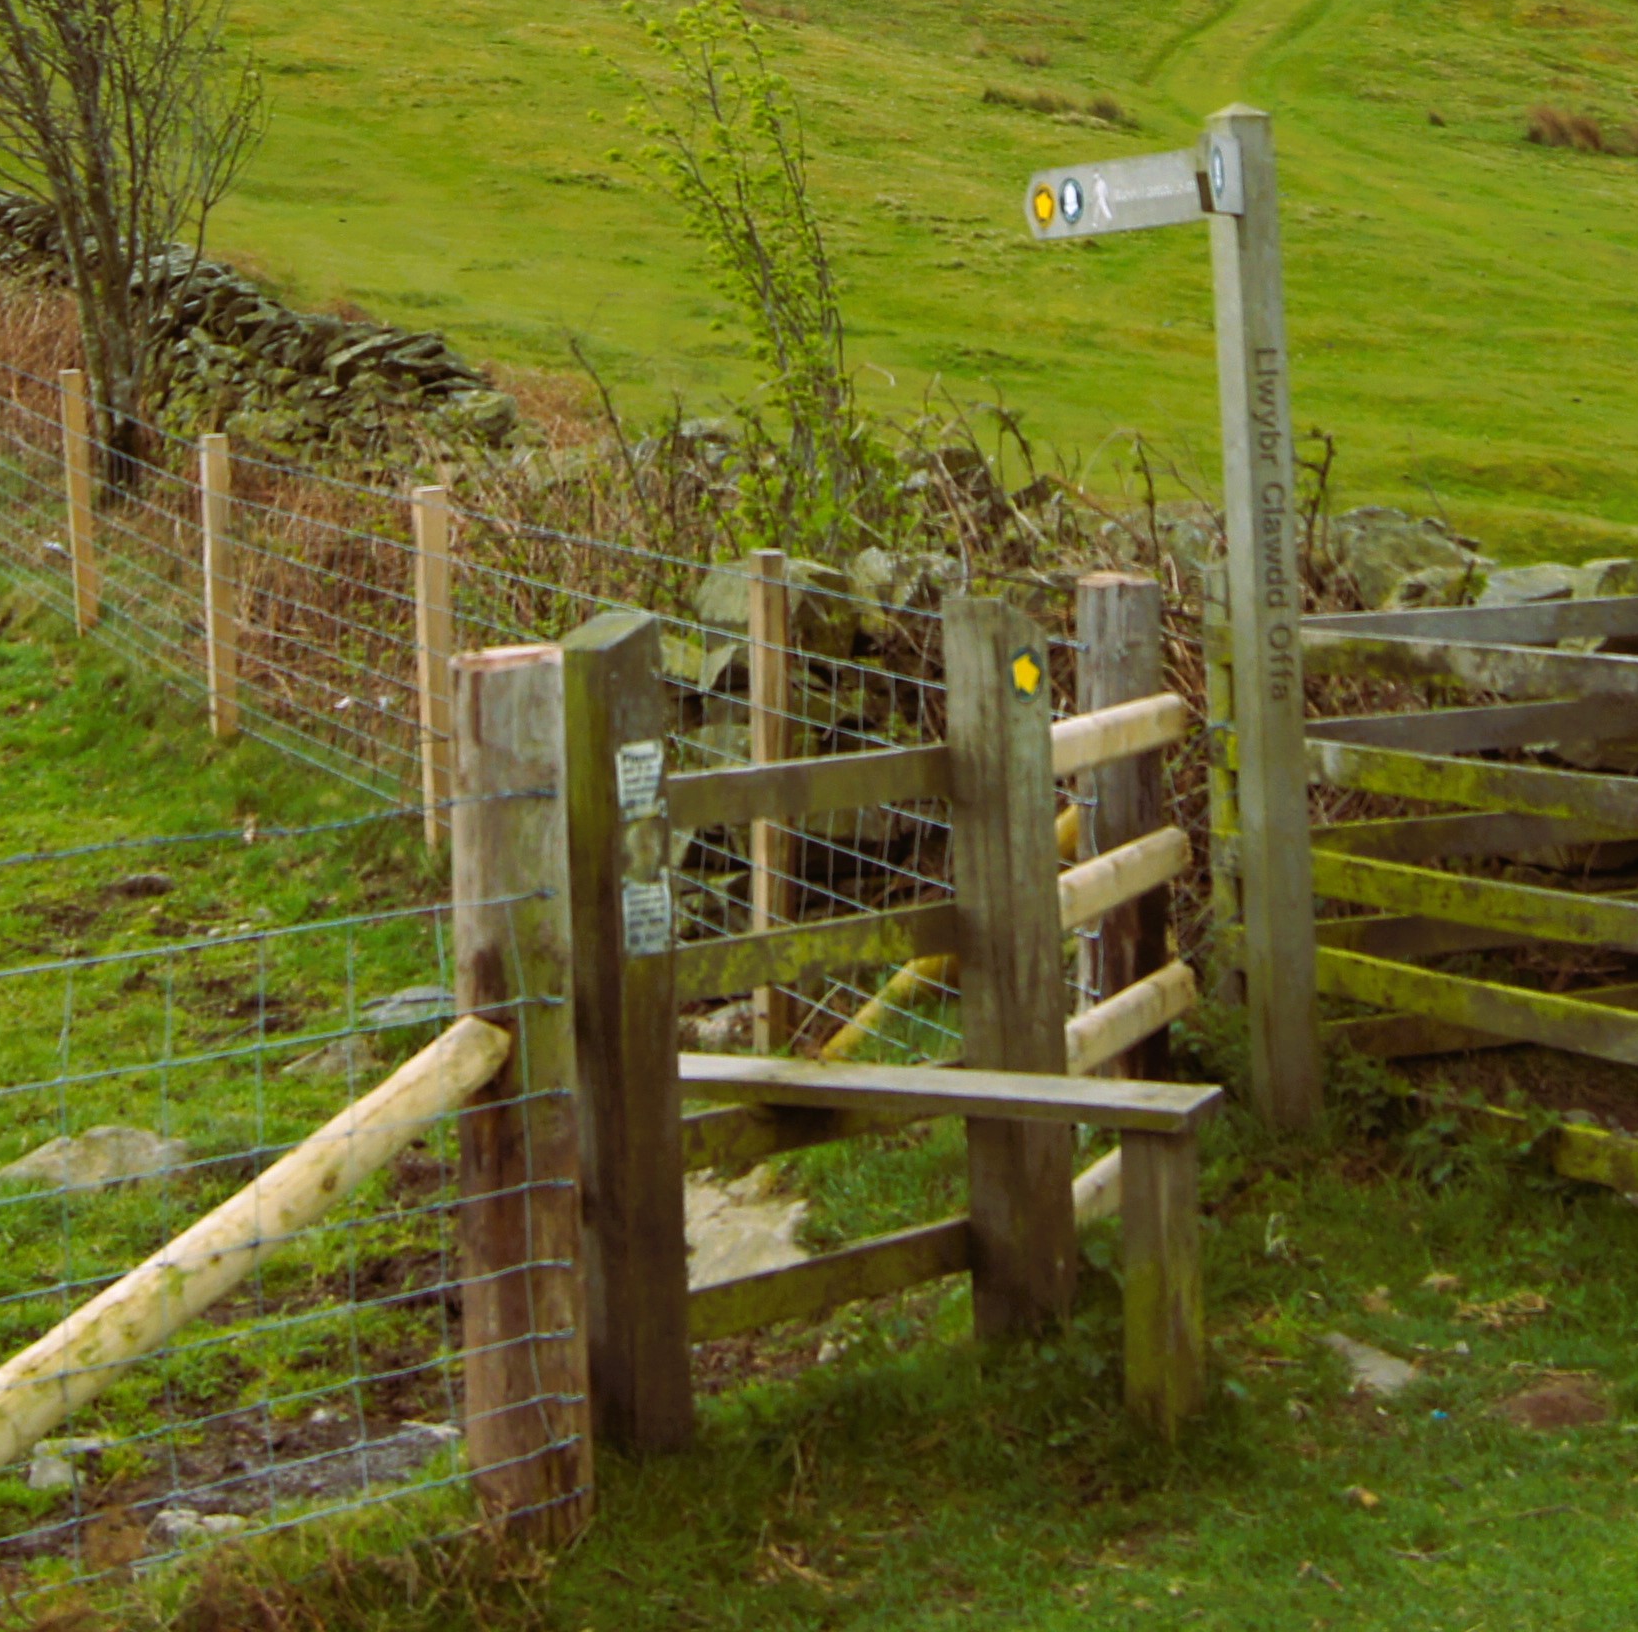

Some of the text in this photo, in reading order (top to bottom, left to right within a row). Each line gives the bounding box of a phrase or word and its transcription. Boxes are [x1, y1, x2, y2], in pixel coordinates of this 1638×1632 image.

[1251, 347, 1294, 701] Llwybr Clawdd Offa
